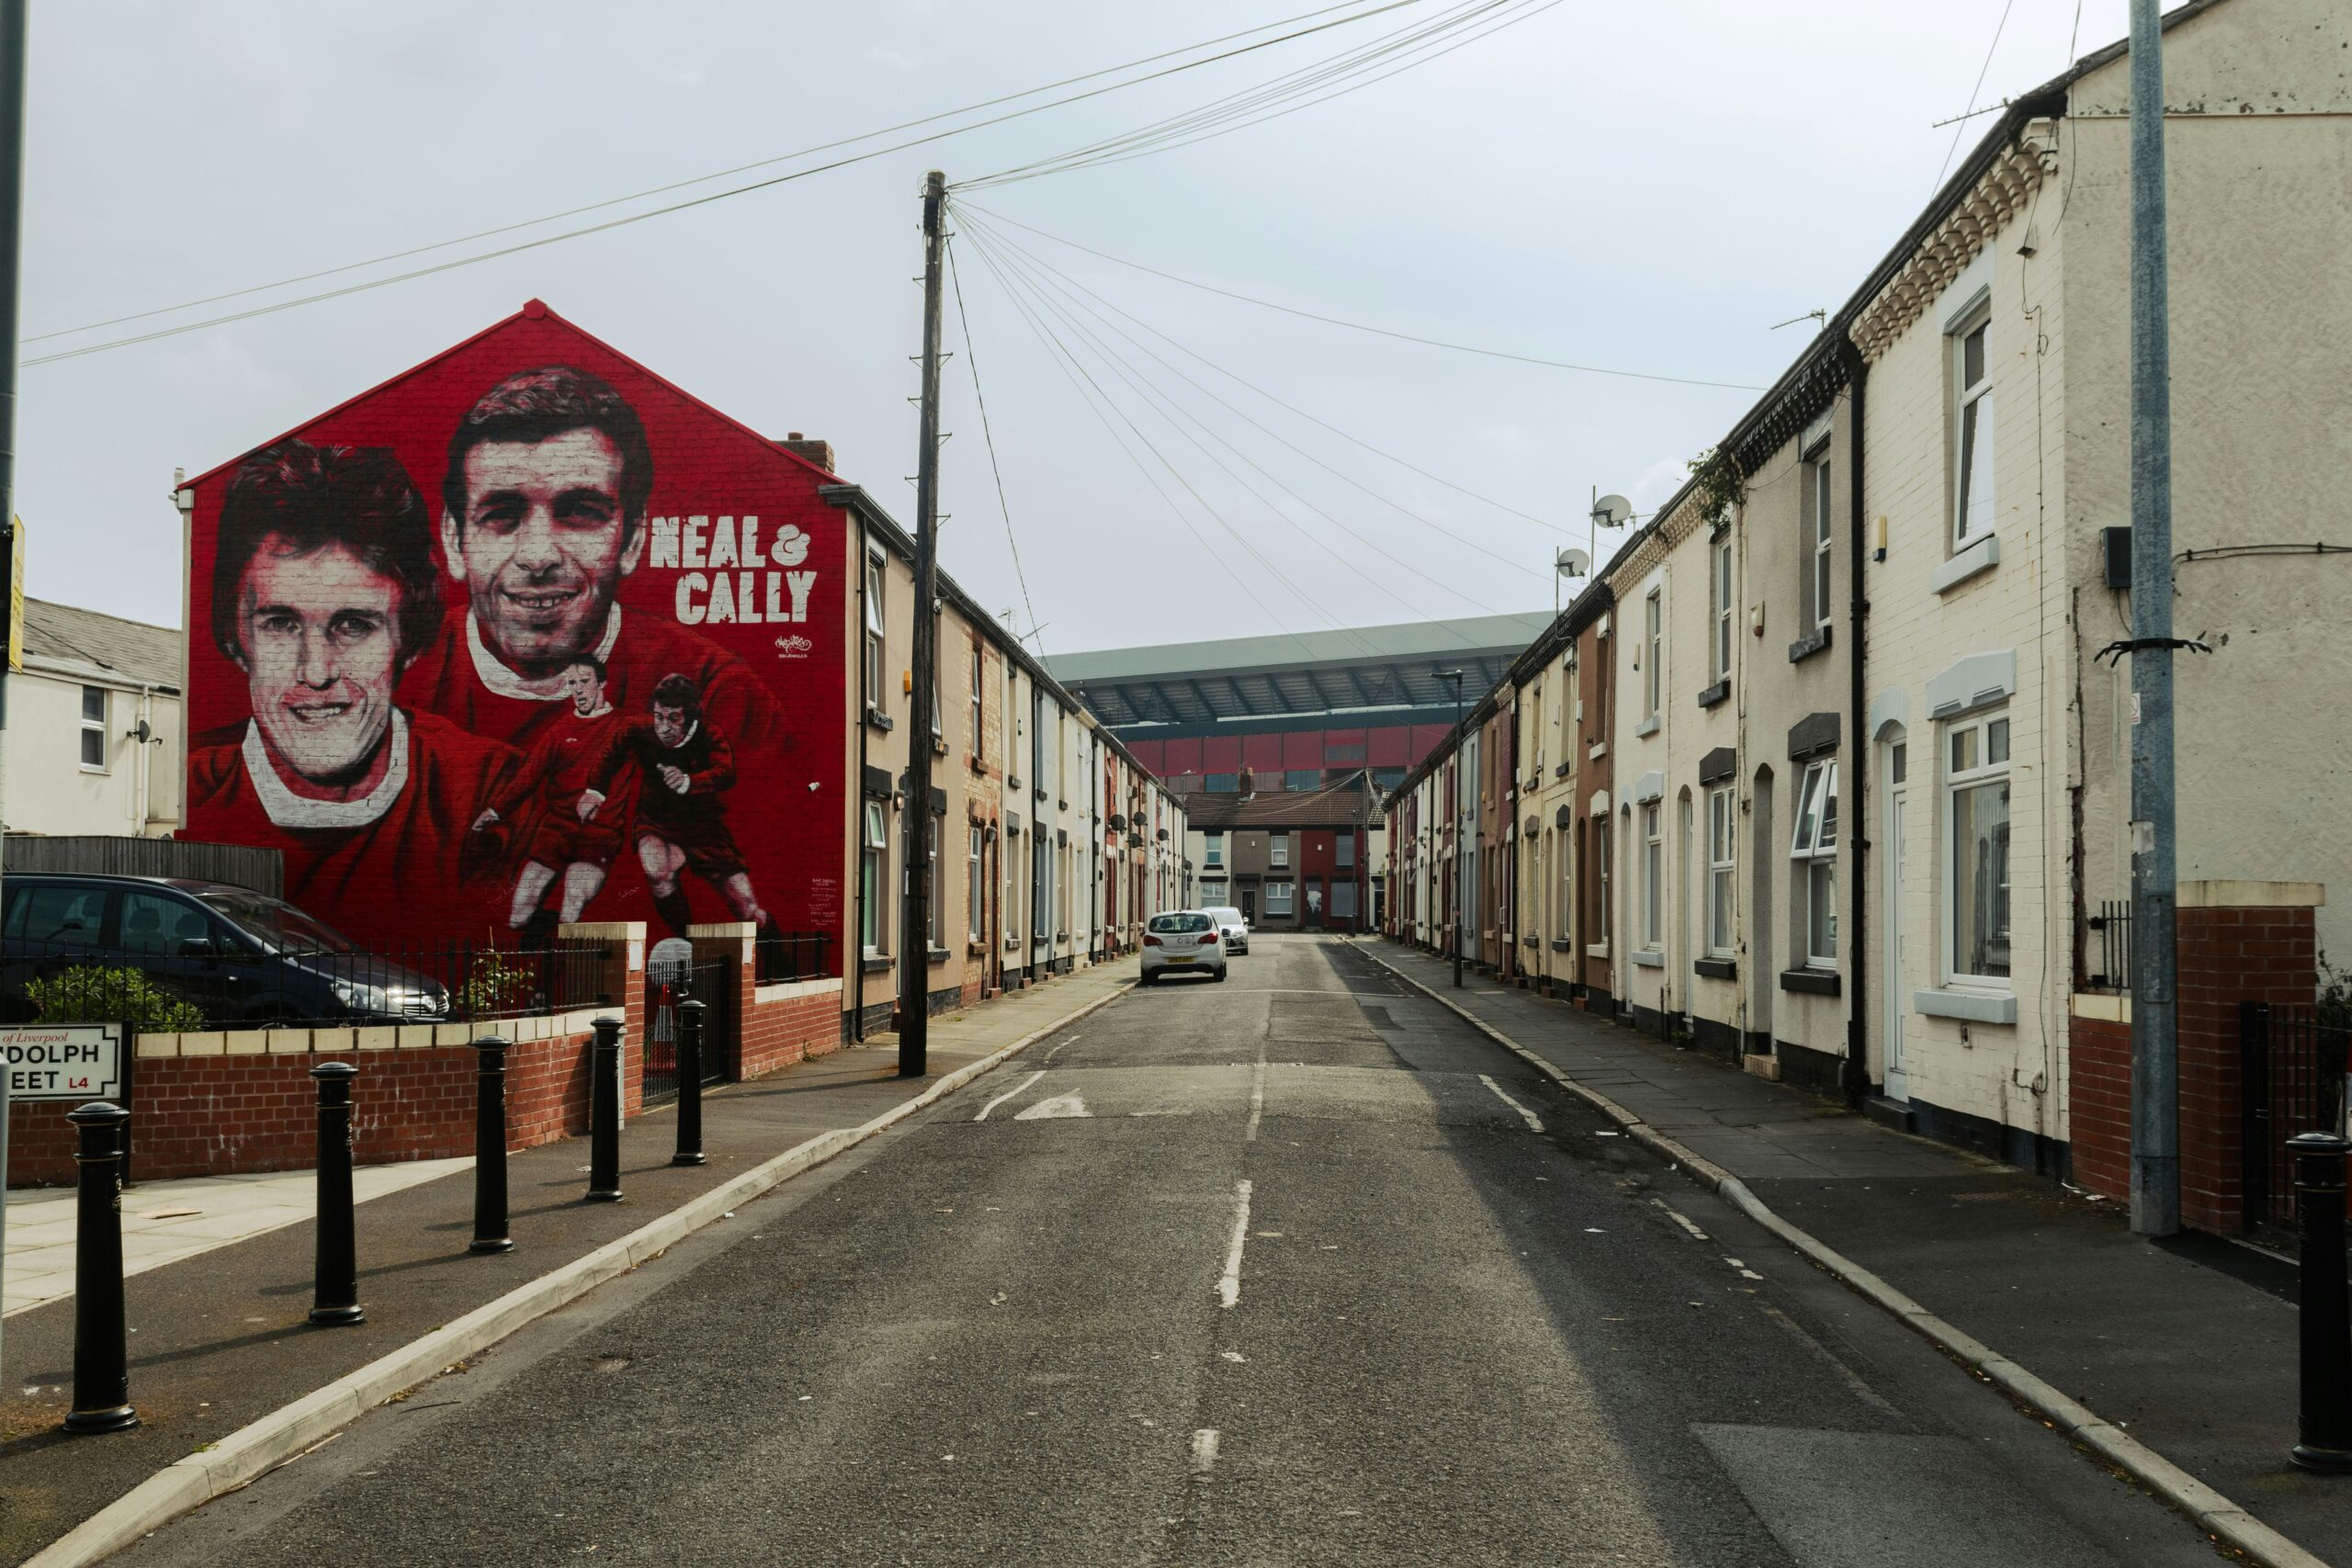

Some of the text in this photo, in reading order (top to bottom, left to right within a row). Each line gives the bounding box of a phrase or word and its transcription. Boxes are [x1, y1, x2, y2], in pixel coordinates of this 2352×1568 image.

[650, 515, 811, 569] NEAL &
[675, 570, 817, 626] CALLY
[3, 1032, 69, 1044] of Liverpool
[0, 1044, 99, 1064] DOLPH
[11, 1071, 89, 1089] EET L4
